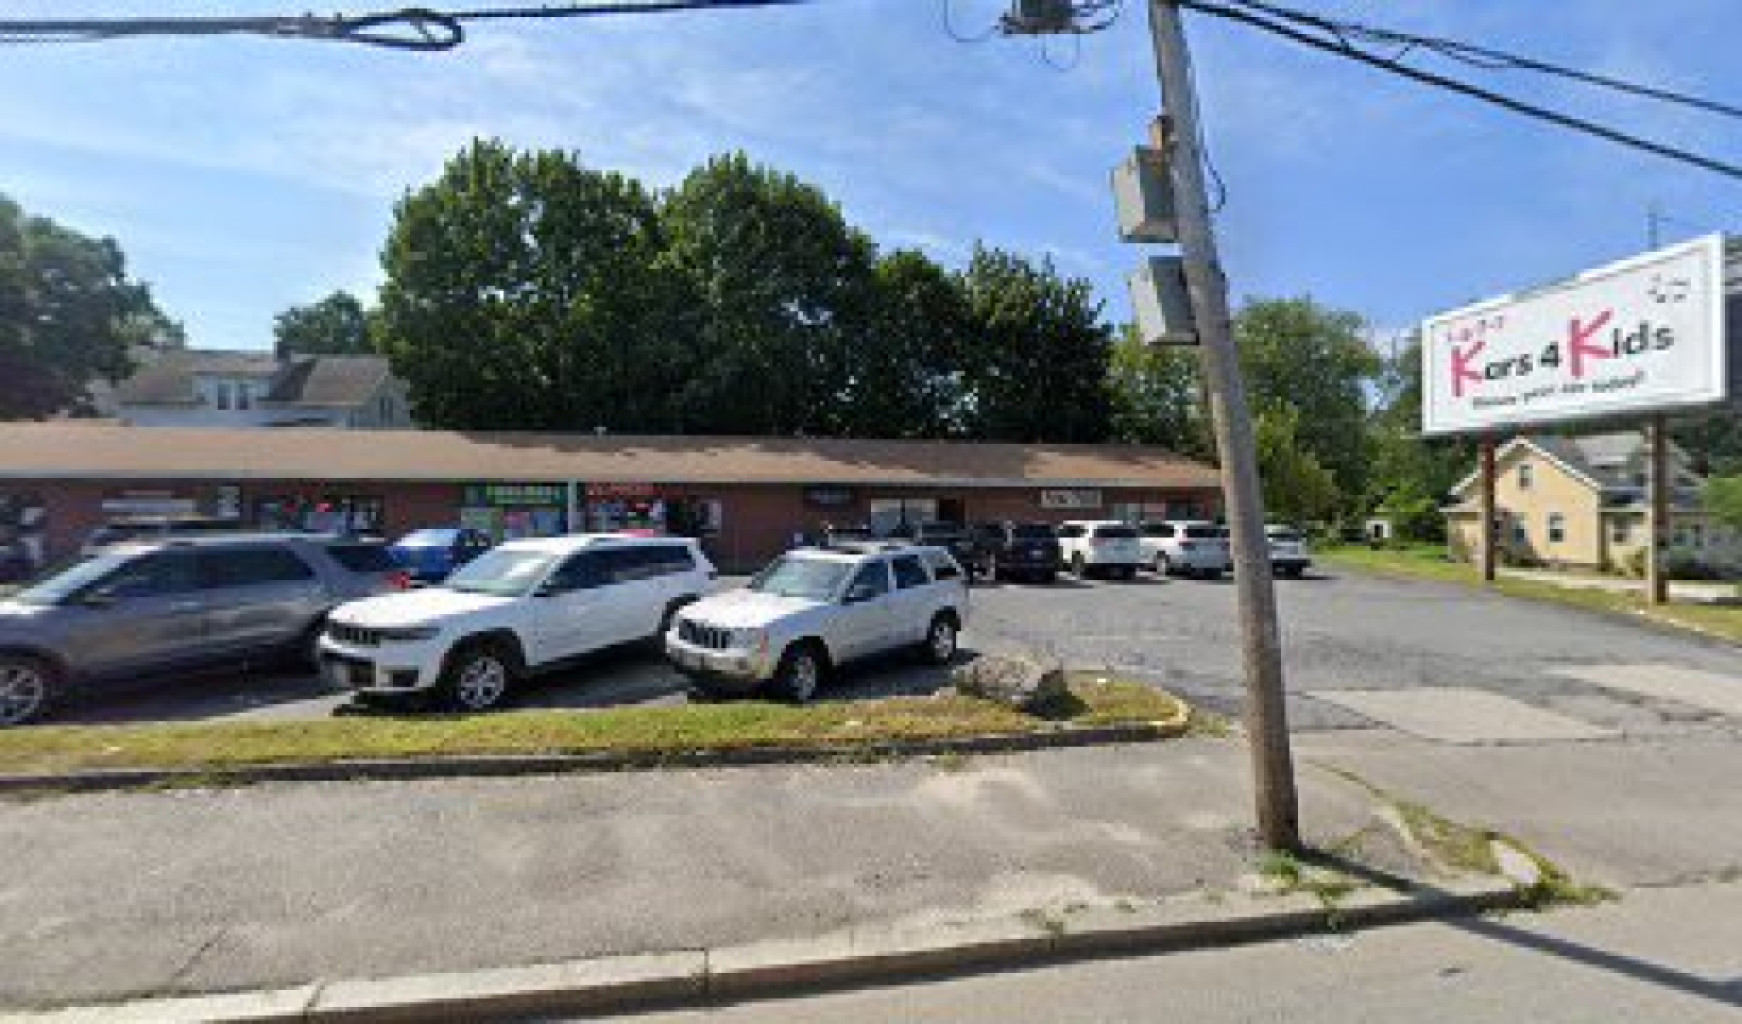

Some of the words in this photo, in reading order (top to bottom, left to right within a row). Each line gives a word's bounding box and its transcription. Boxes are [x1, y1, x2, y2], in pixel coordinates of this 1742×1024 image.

[1450, 341, 1534, 397] Kars
[1540, 341, 1561, 368] 4
[1569, 308, 1675, 379] Kids
